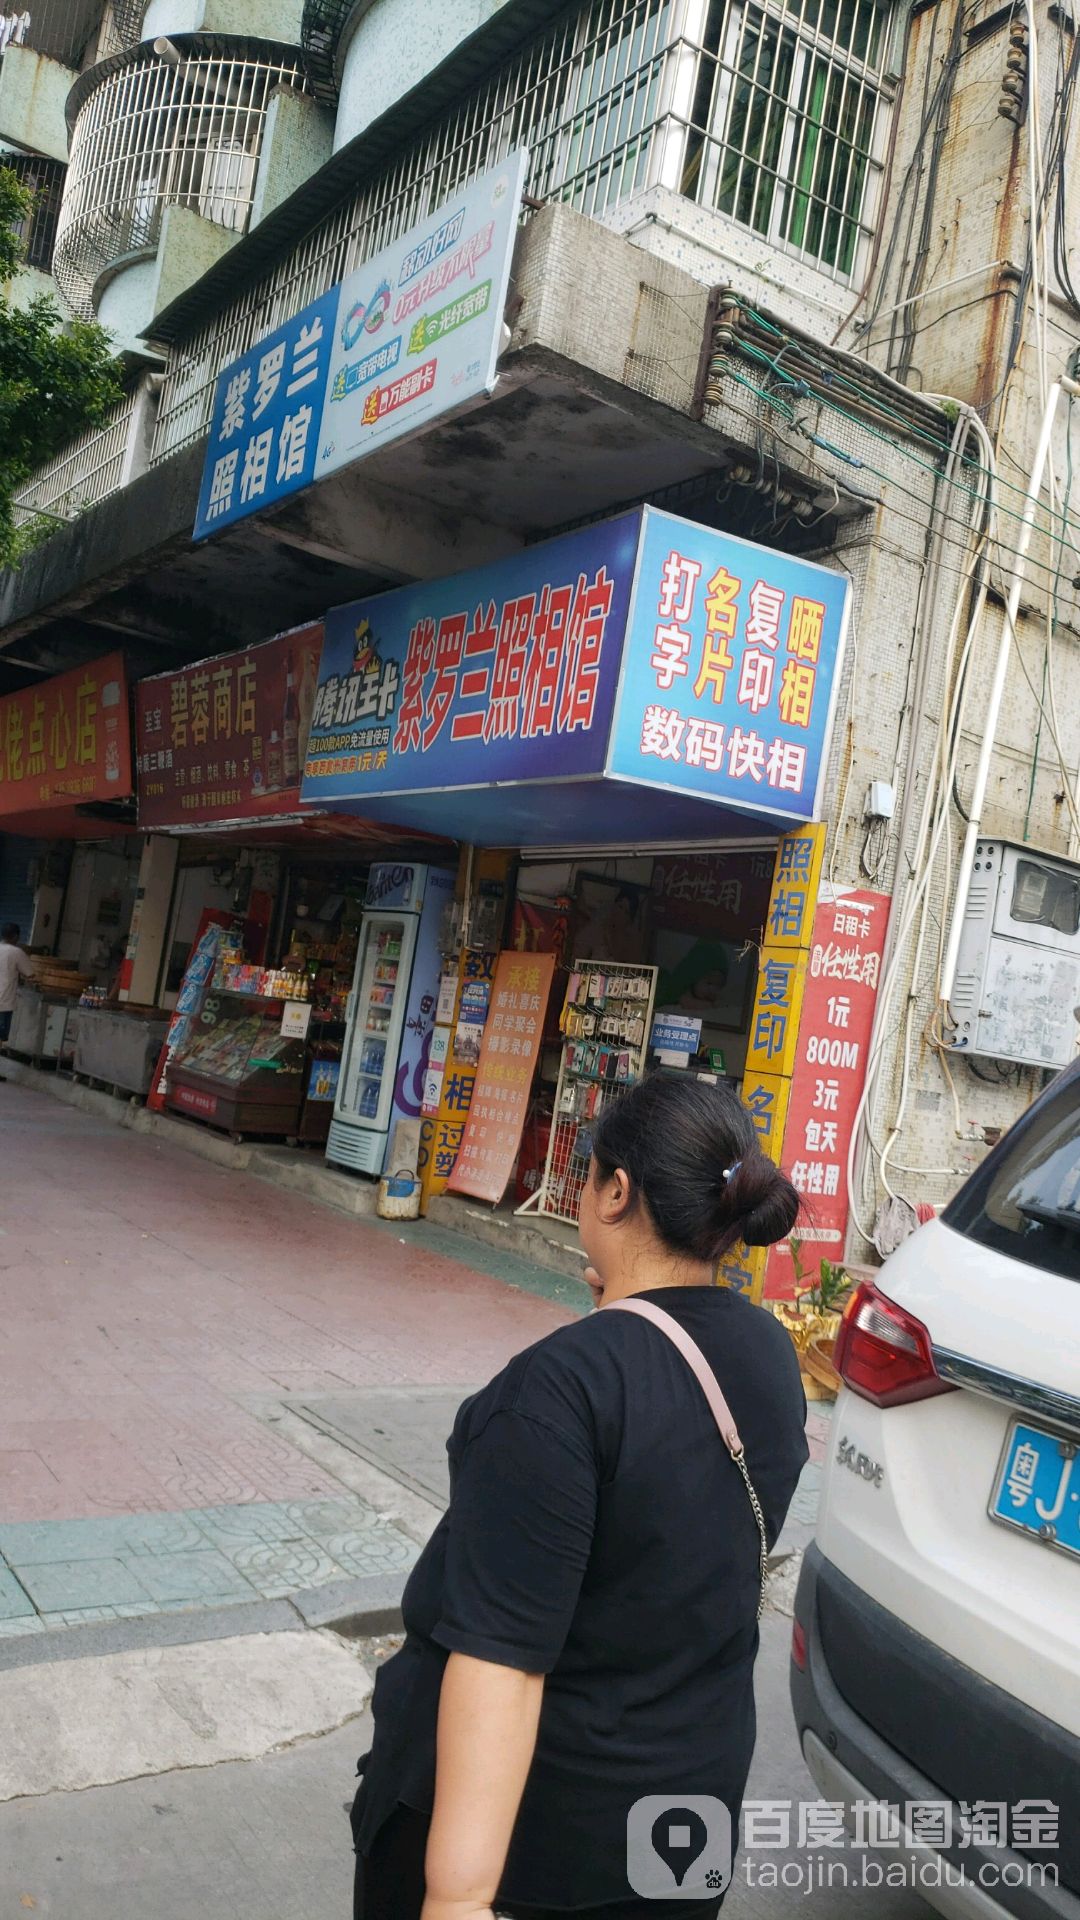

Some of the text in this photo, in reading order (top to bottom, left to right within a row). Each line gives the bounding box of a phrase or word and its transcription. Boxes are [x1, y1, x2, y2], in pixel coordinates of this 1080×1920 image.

[438, 285, 489, 335] 光纤宽带
[218, 316, 324, 443] 紫罗兰
[356, 340, 399, 385] 宽带电视
[387, 364, 434, 410] 万能副卡
[205, 404, 313, 521] 照相馆
[650, 550, 702, 690] 打字
[693, 566, 742, 705] 名片
[737, 578, 785, 714] 复印
[392, 565, 615, 754] 紫罗兰照相馆
[778, 595, 826, 729] 晒相
[0, 673, 98, 782] 佬点心店
[170, 655, 257, 750] 碧蓉商店
[312, 662, 399, 729] 腾讯王卡
[639, 704, 807, 794] 数码快相
[769, 836, 814, 938] 照相
[833, 913, 871, 939] 日租卡
[506, 964, 541, 991] 承接
[822, 941, 881, 991] 任性用
[492, 1013, 537, 1034] 同学聚会
[655, 1027, 698, 1042] 业务受理点
[753, 958, 796, 1061] 复印
[826, 996, 851, 1028] 1元
[806, 1036, 859, 1071] 800M
[812, 1078, 840, 1112] 3元
[805, 1118, 837, 1153] 包天
[790, 1161, 841, 1197] 任性用
[1006, 1442, 1079, 1522] 粤J·
